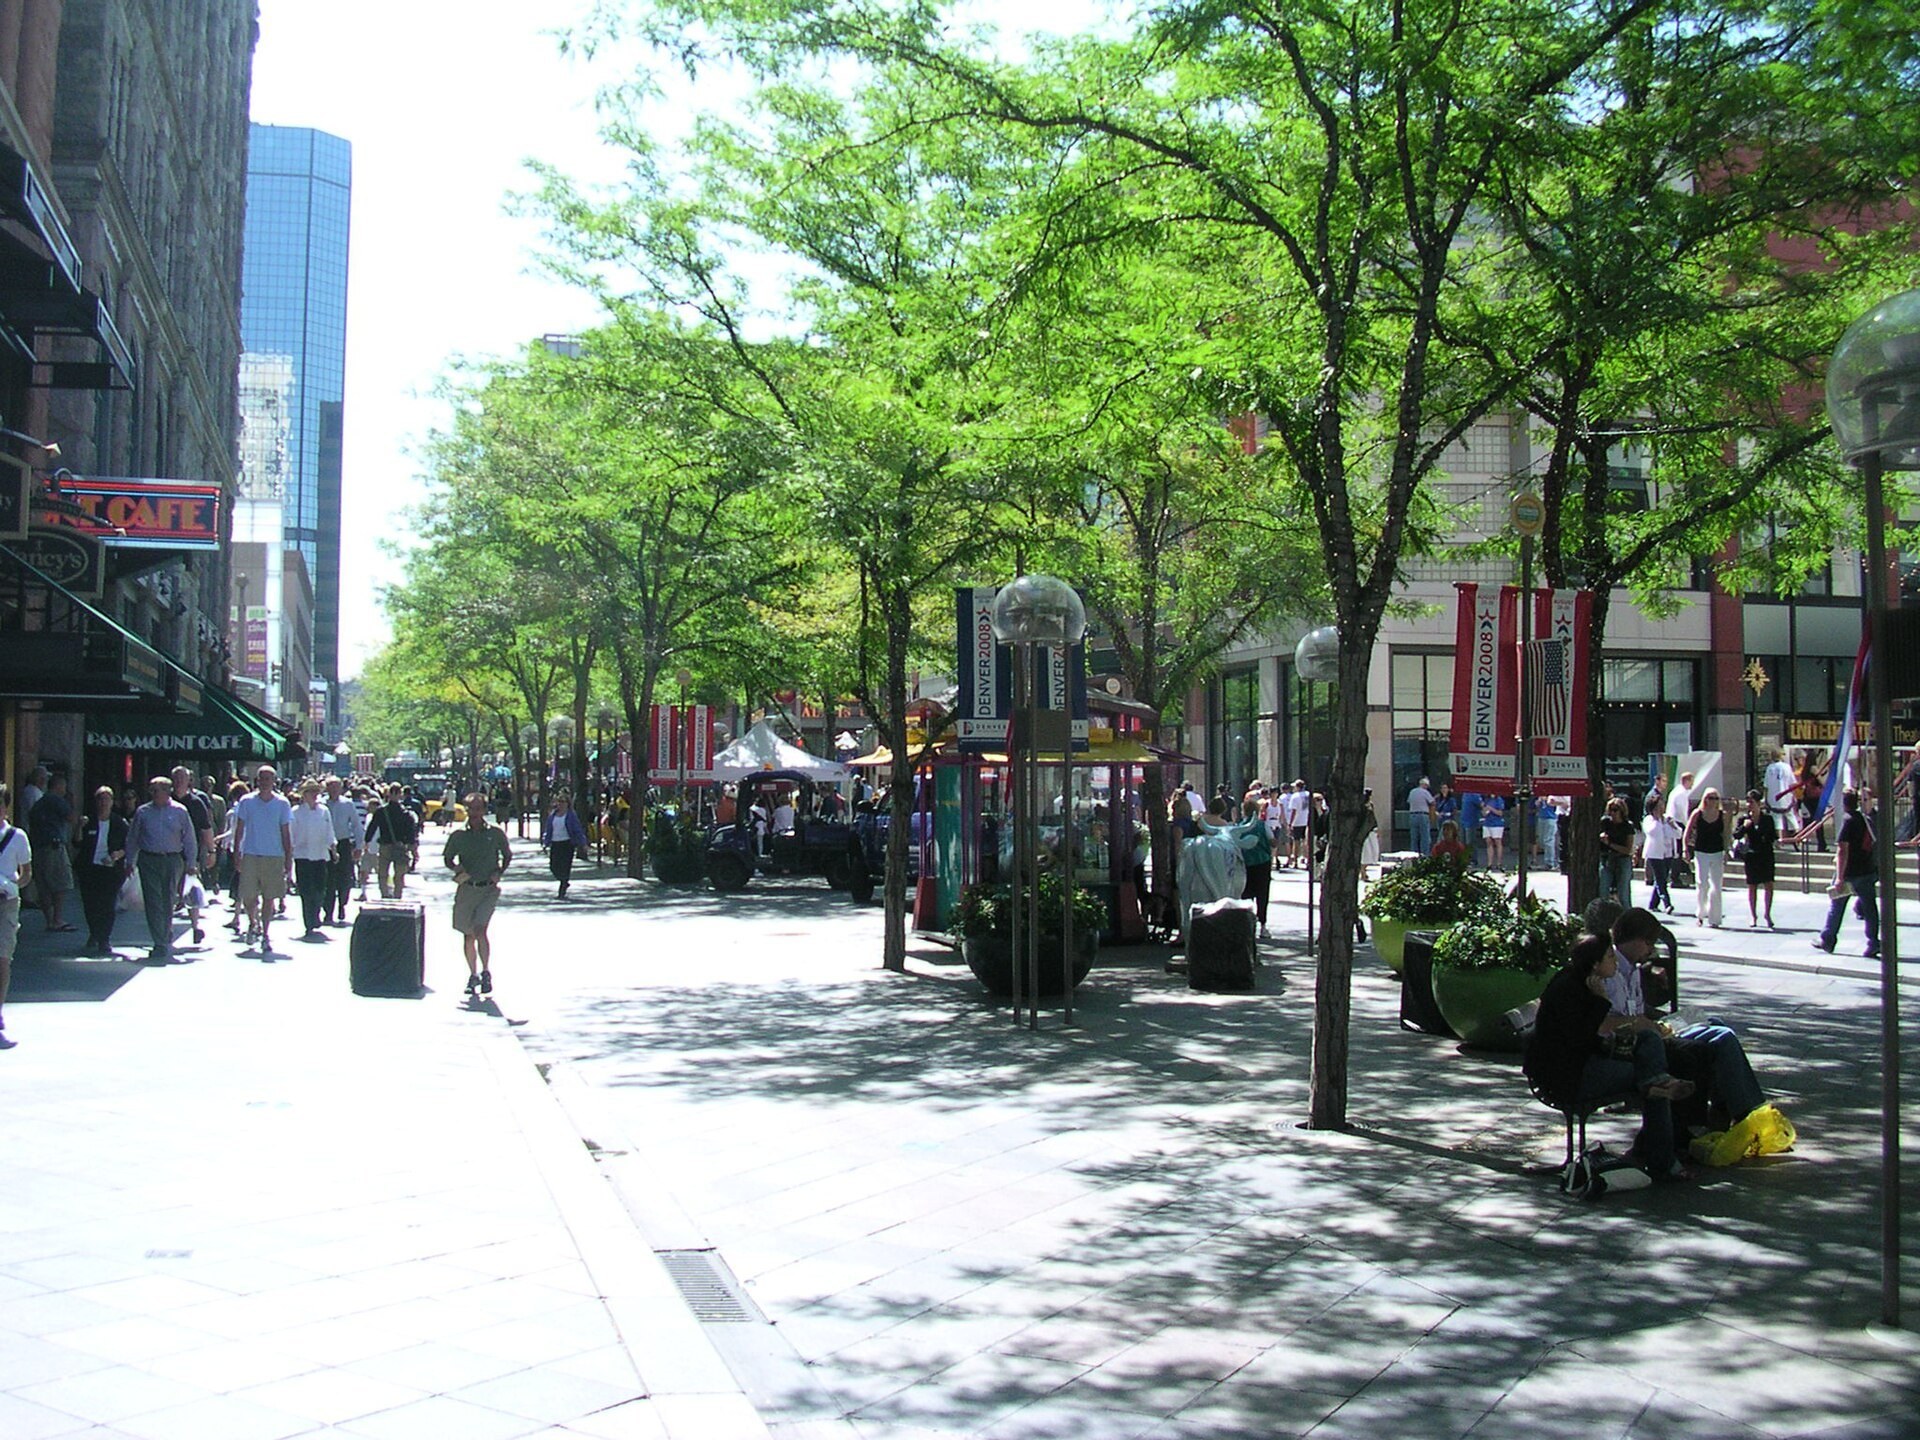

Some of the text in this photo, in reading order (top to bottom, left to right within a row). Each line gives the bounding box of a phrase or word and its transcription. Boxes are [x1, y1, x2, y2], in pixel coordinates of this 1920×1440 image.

[107, 496, 206, 530] CAFE
[978, 623, 992, 715] DENVER2008
[1475, 631, 1494, 748] DENVER2008
[87, 731, 243, 750] PARAMOUNT CAFE
[1471, 759, 1508, 767] DENVER
[1551, 761, 1582, 769] DENVER
